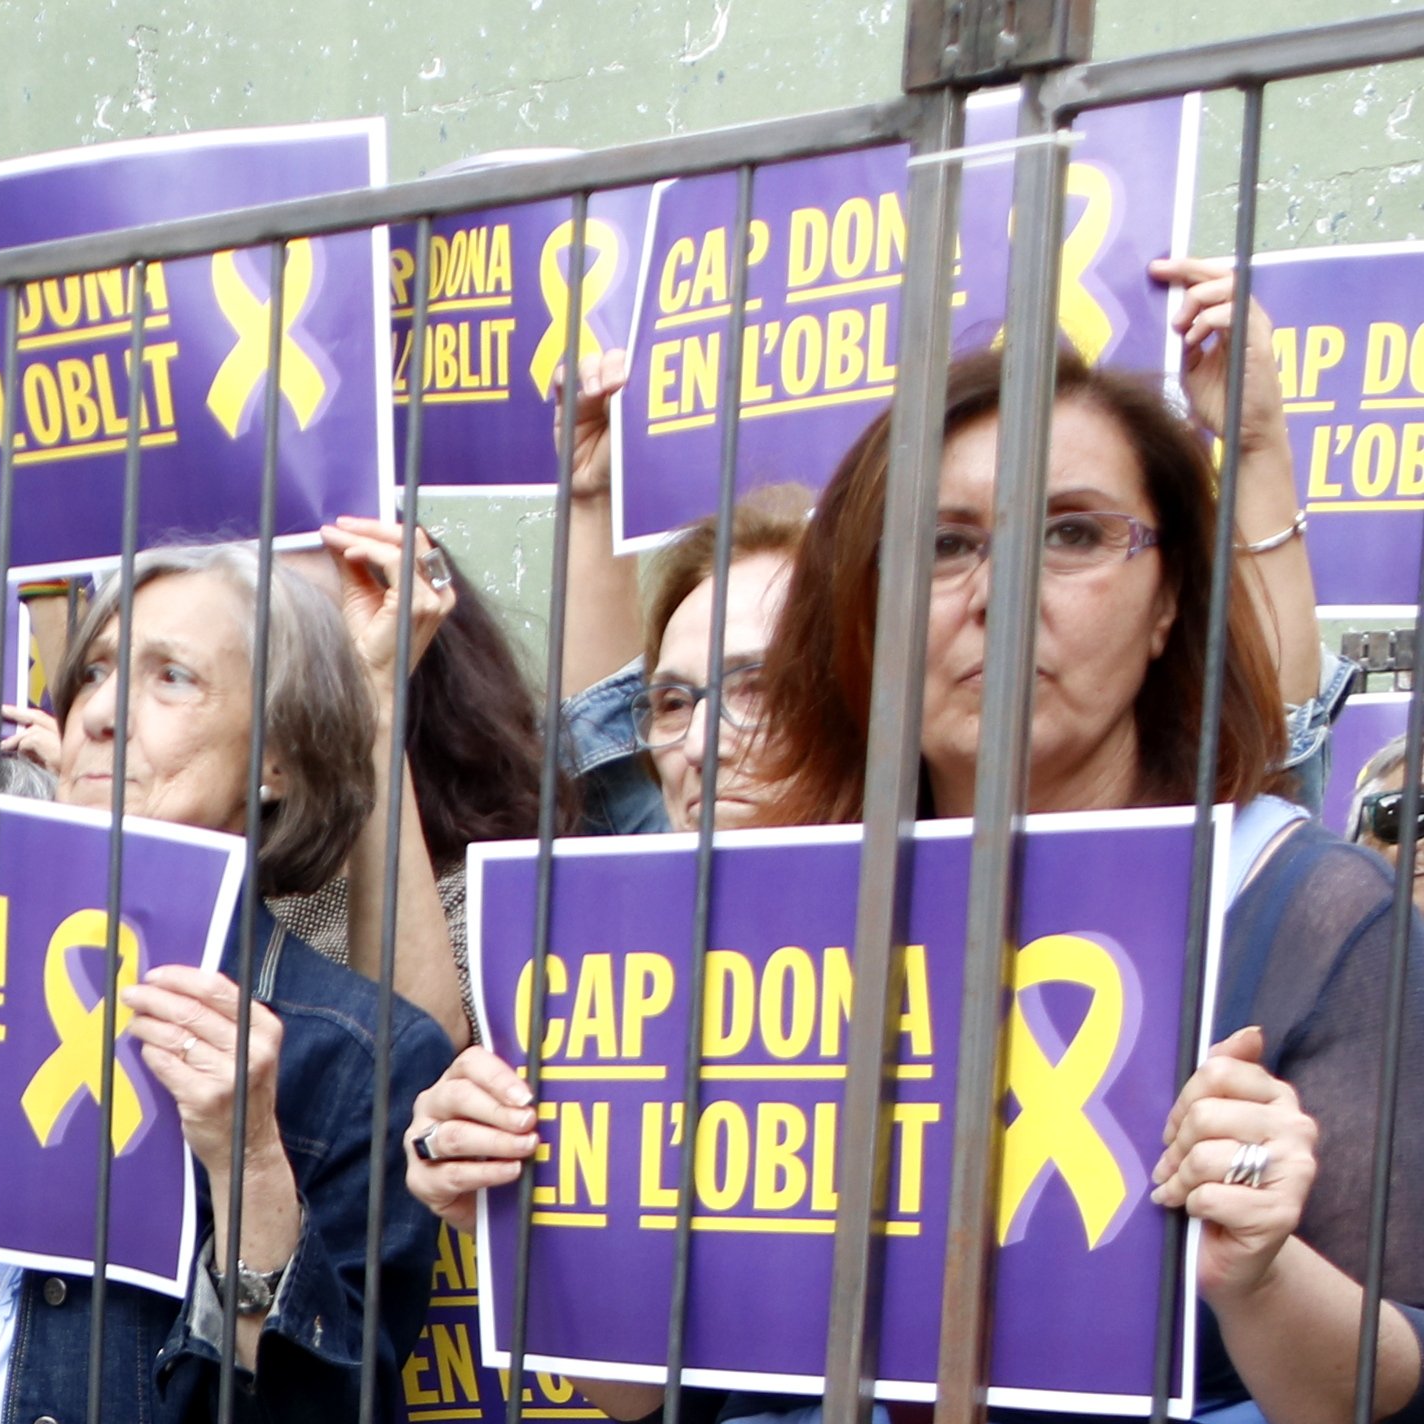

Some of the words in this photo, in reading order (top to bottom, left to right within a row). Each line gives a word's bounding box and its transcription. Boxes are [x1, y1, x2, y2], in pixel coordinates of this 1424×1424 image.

[429, 224, 512, 300] DONA
[648, 331, 720, 419] EN
[514, 952, 675, 1059] CAP
[640, 1100, 941, 1213] L'OBLT
[402, 1324, 479, 1405] EN
